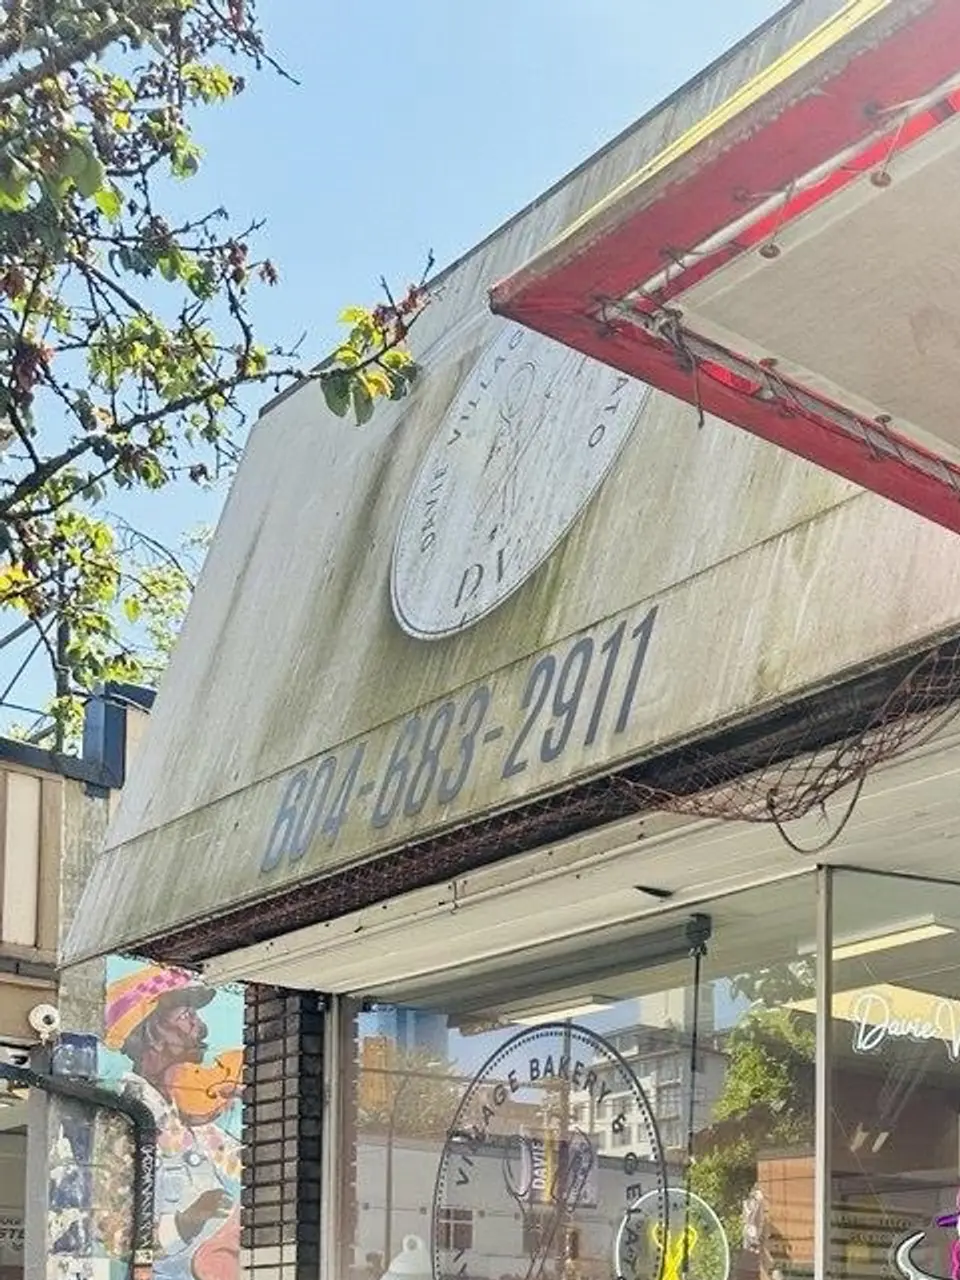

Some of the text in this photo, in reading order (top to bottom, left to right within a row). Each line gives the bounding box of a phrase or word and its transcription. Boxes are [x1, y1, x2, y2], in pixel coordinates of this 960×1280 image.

[446, 330, 525, 446] VILLAG
[260, 604, 660, 874] 604-683-2911
[853, 993, 942, 1051] Davie
[530, 1055, 613, 1104] BAKERY
